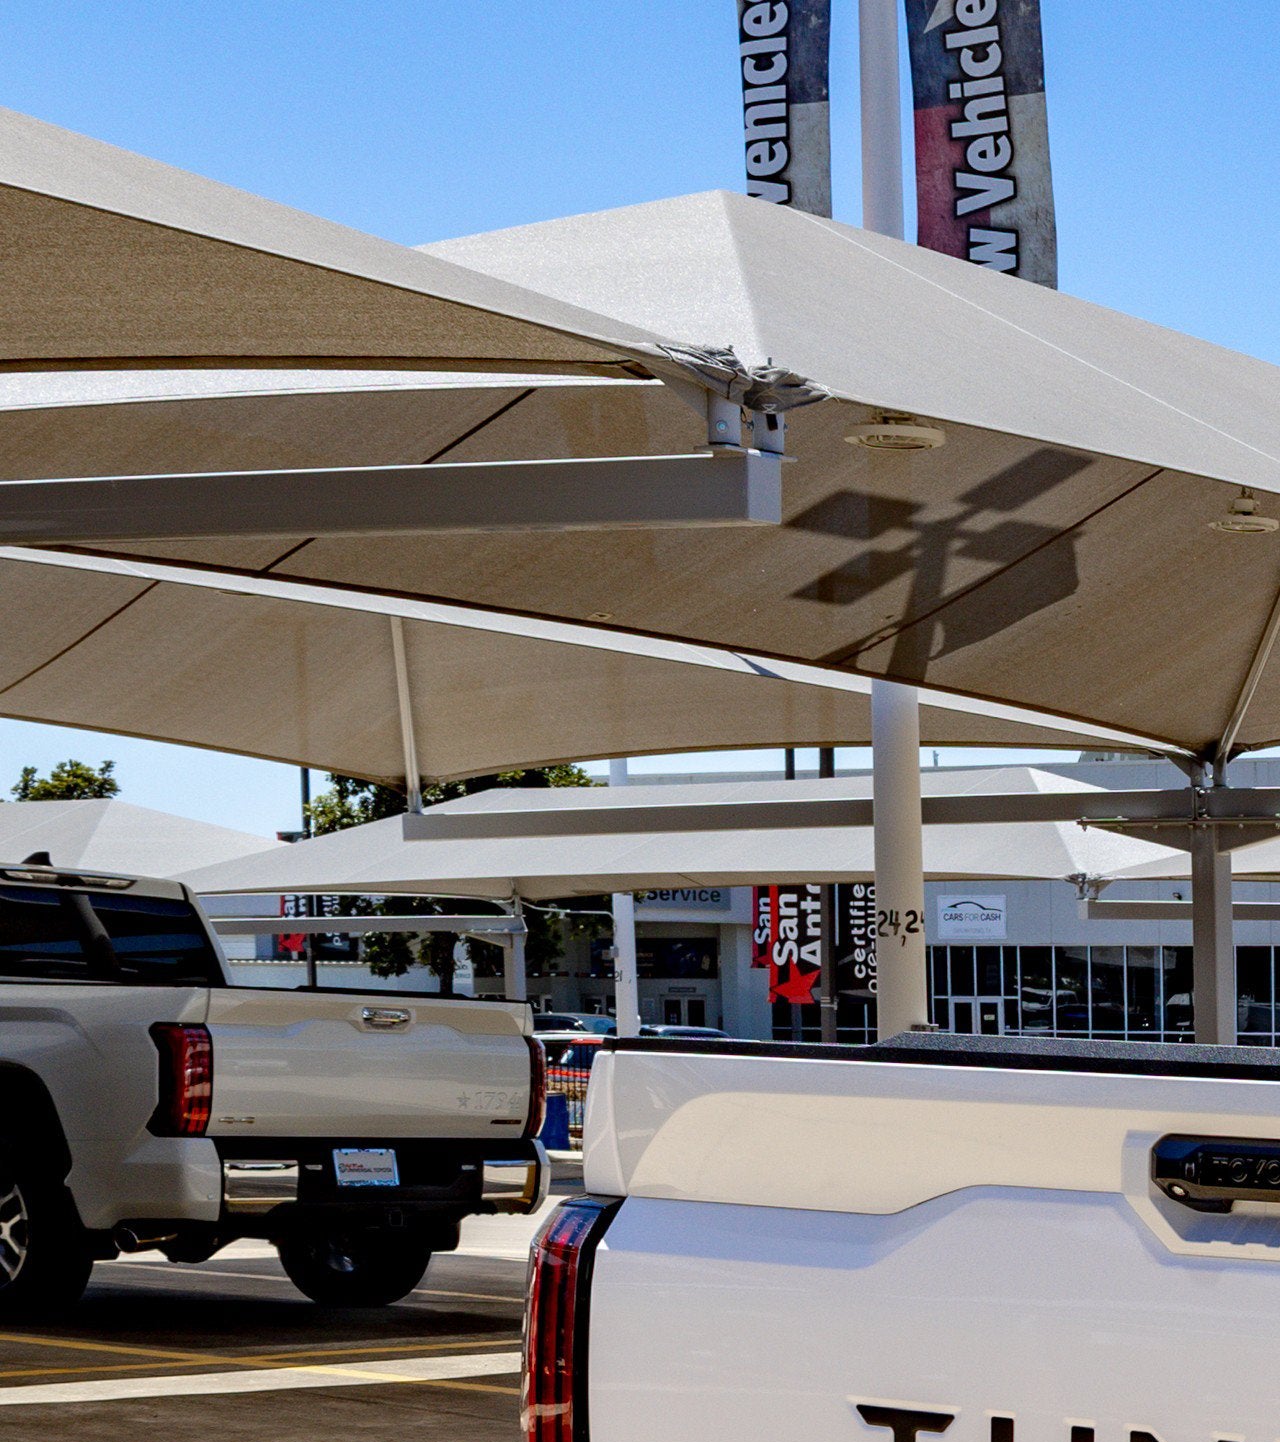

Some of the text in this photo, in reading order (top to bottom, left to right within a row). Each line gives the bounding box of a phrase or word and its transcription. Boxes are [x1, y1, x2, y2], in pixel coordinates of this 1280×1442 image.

[754, 897, 771, 945] San
[772, 893, 799, 966] San
[943, 913, 964, 921] CARS
[980, 913, 1001, 921] CASH
